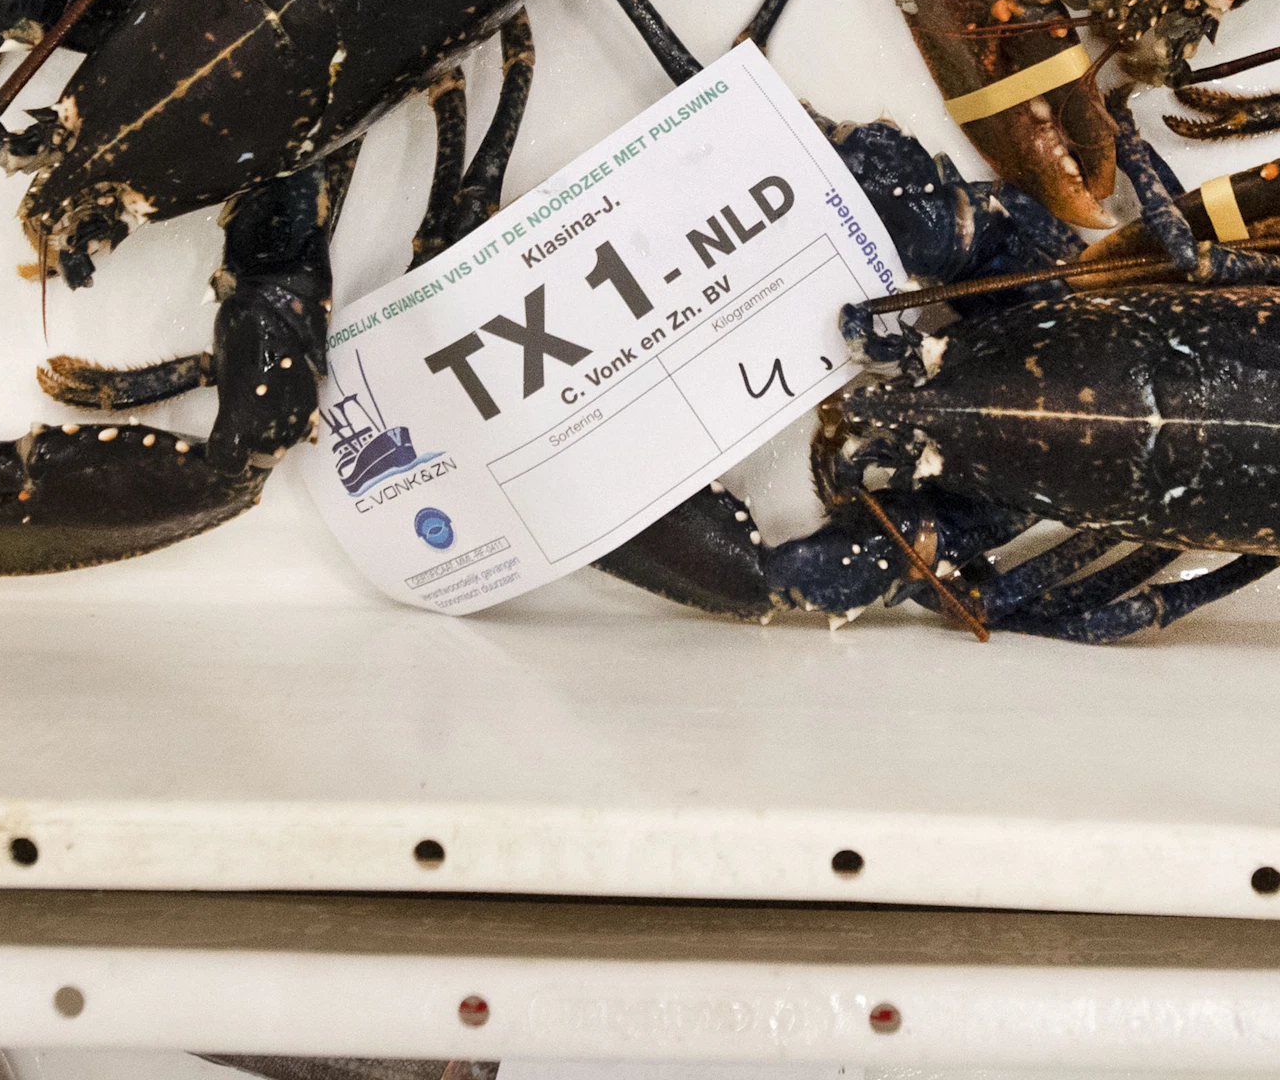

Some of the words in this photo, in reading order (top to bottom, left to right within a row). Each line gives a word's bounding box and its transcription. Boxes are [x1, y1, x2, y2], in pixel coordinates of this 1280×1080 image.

[382, 279, 444, 320] GEVANGEN
[443, 261, 472, 284] VIS
[473, 240, 500, 266] UIT
[501, 223, 527, 246] DE
[526, 161, 613, 228] NOORDZEE
[612, 136, 648, 167] MET
[648, 80, 729, 141] PULSWING
[521, 195, 621, 269] Klasina-J.
[824, 187, 897, 296] ngstgebied:
[424, 283, 594, 421] TX
[585, 240, 654, 320] 1
[685, 175, 795, 270] NLD
[561, 386, 585, 406] C.
[585, 346, 638, 387] Vonk
[640, 327, 666, 352] en
[665, 302, 702, 331] Zn.
[702, 275, 732, 306] BV
[711, 276, 785, 333] Kilogrammen
[548, 408, 603, 448] Sortering
[481, 557, 520, 580] gevangen
